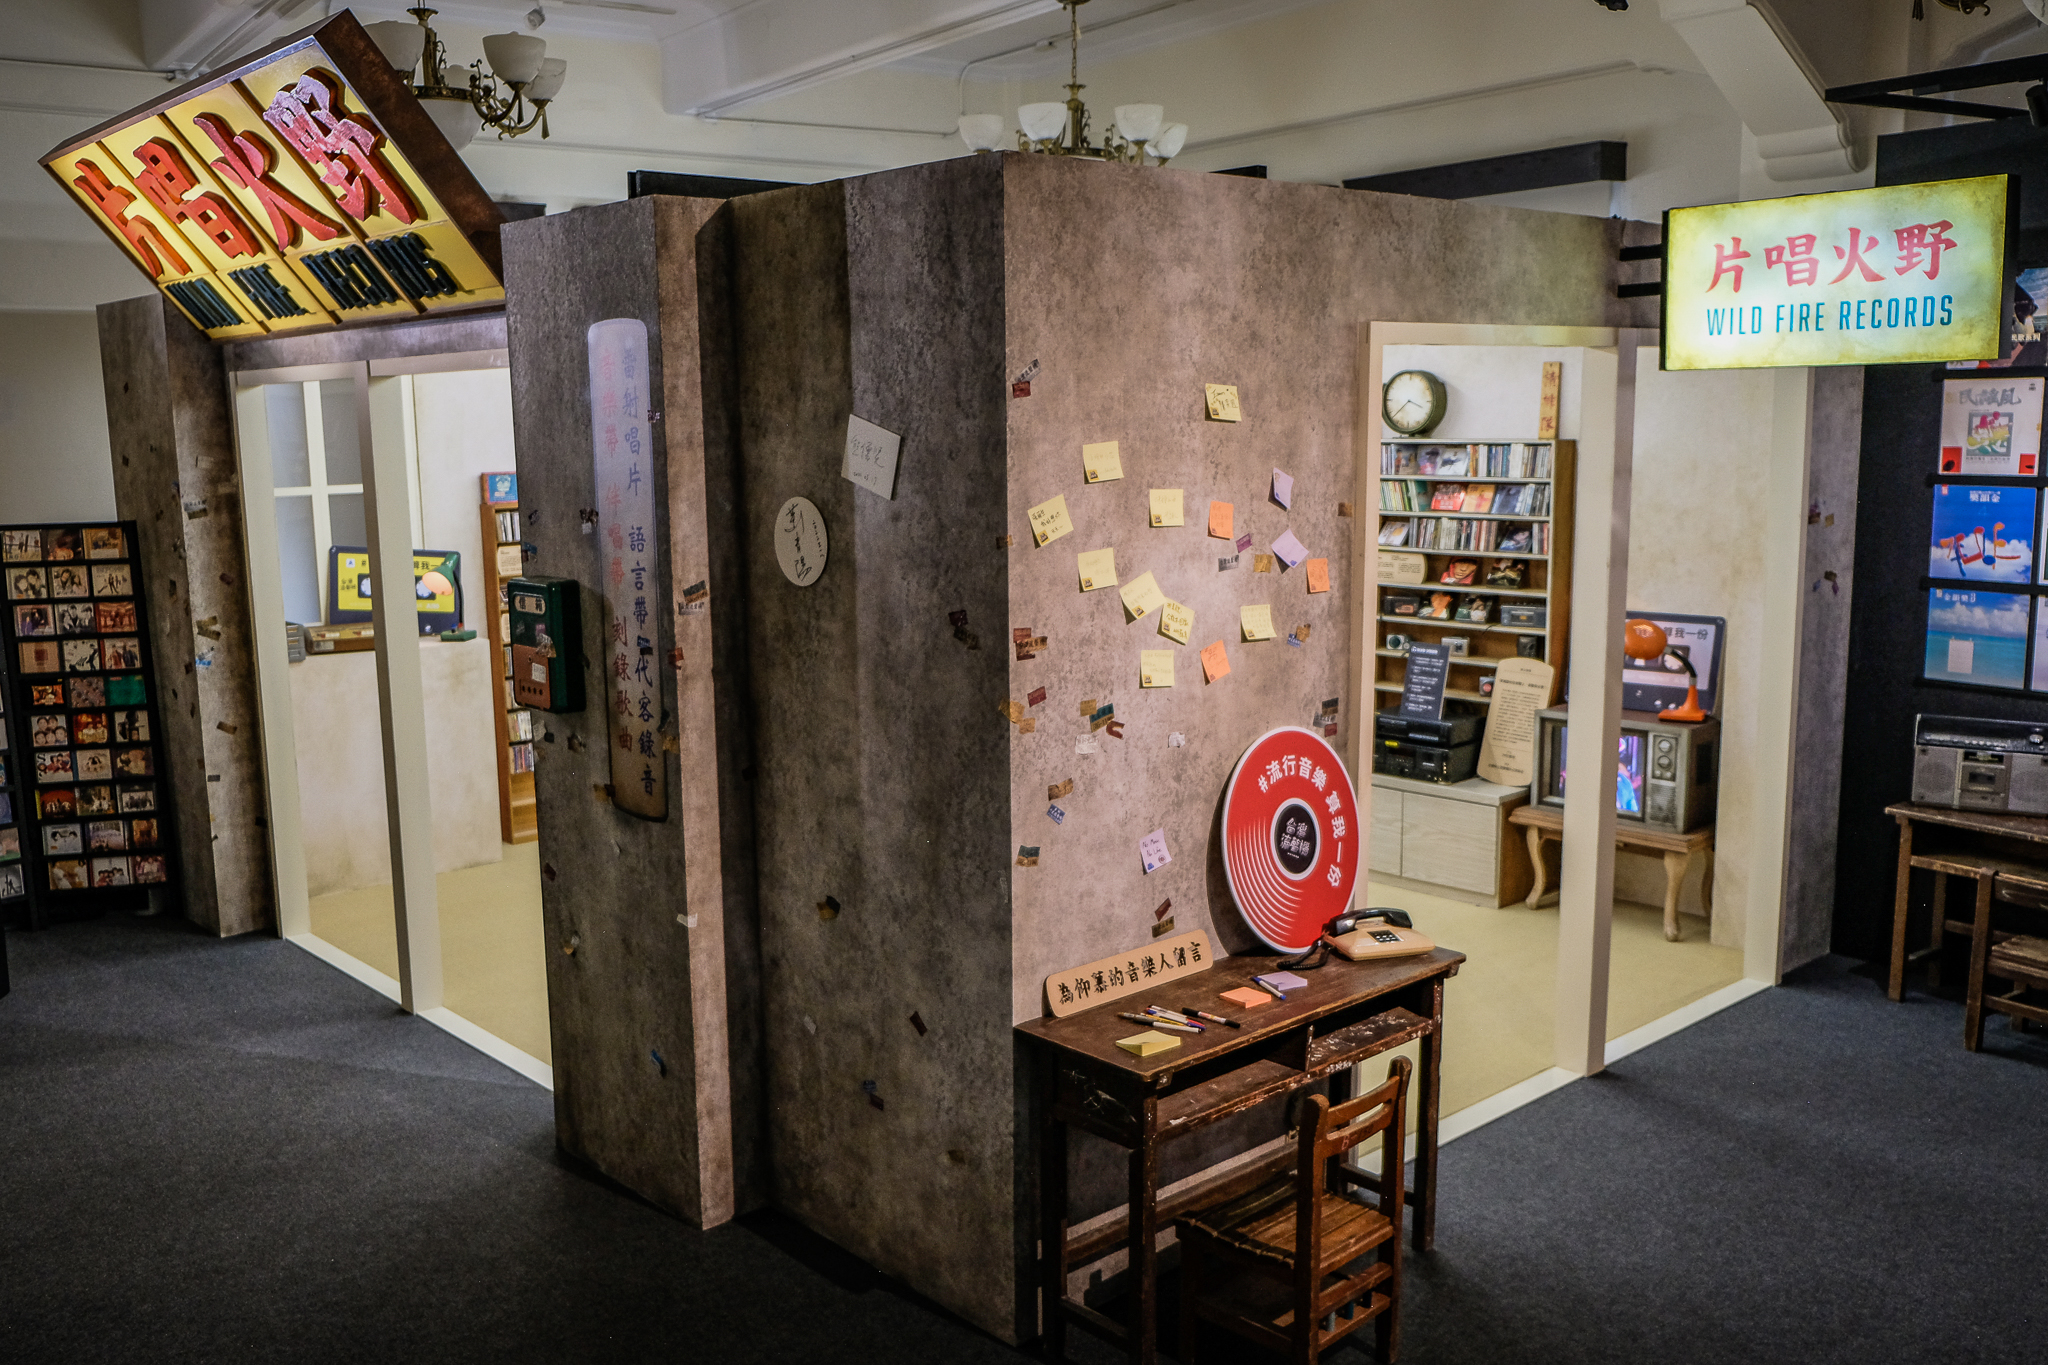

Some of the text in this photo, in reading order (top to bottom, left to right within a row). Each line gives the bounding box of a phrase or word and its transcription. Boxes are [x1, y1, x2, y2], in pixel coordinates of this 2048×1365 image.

[1707, 294, 1953, 336] WILD FIRE RECORDS
